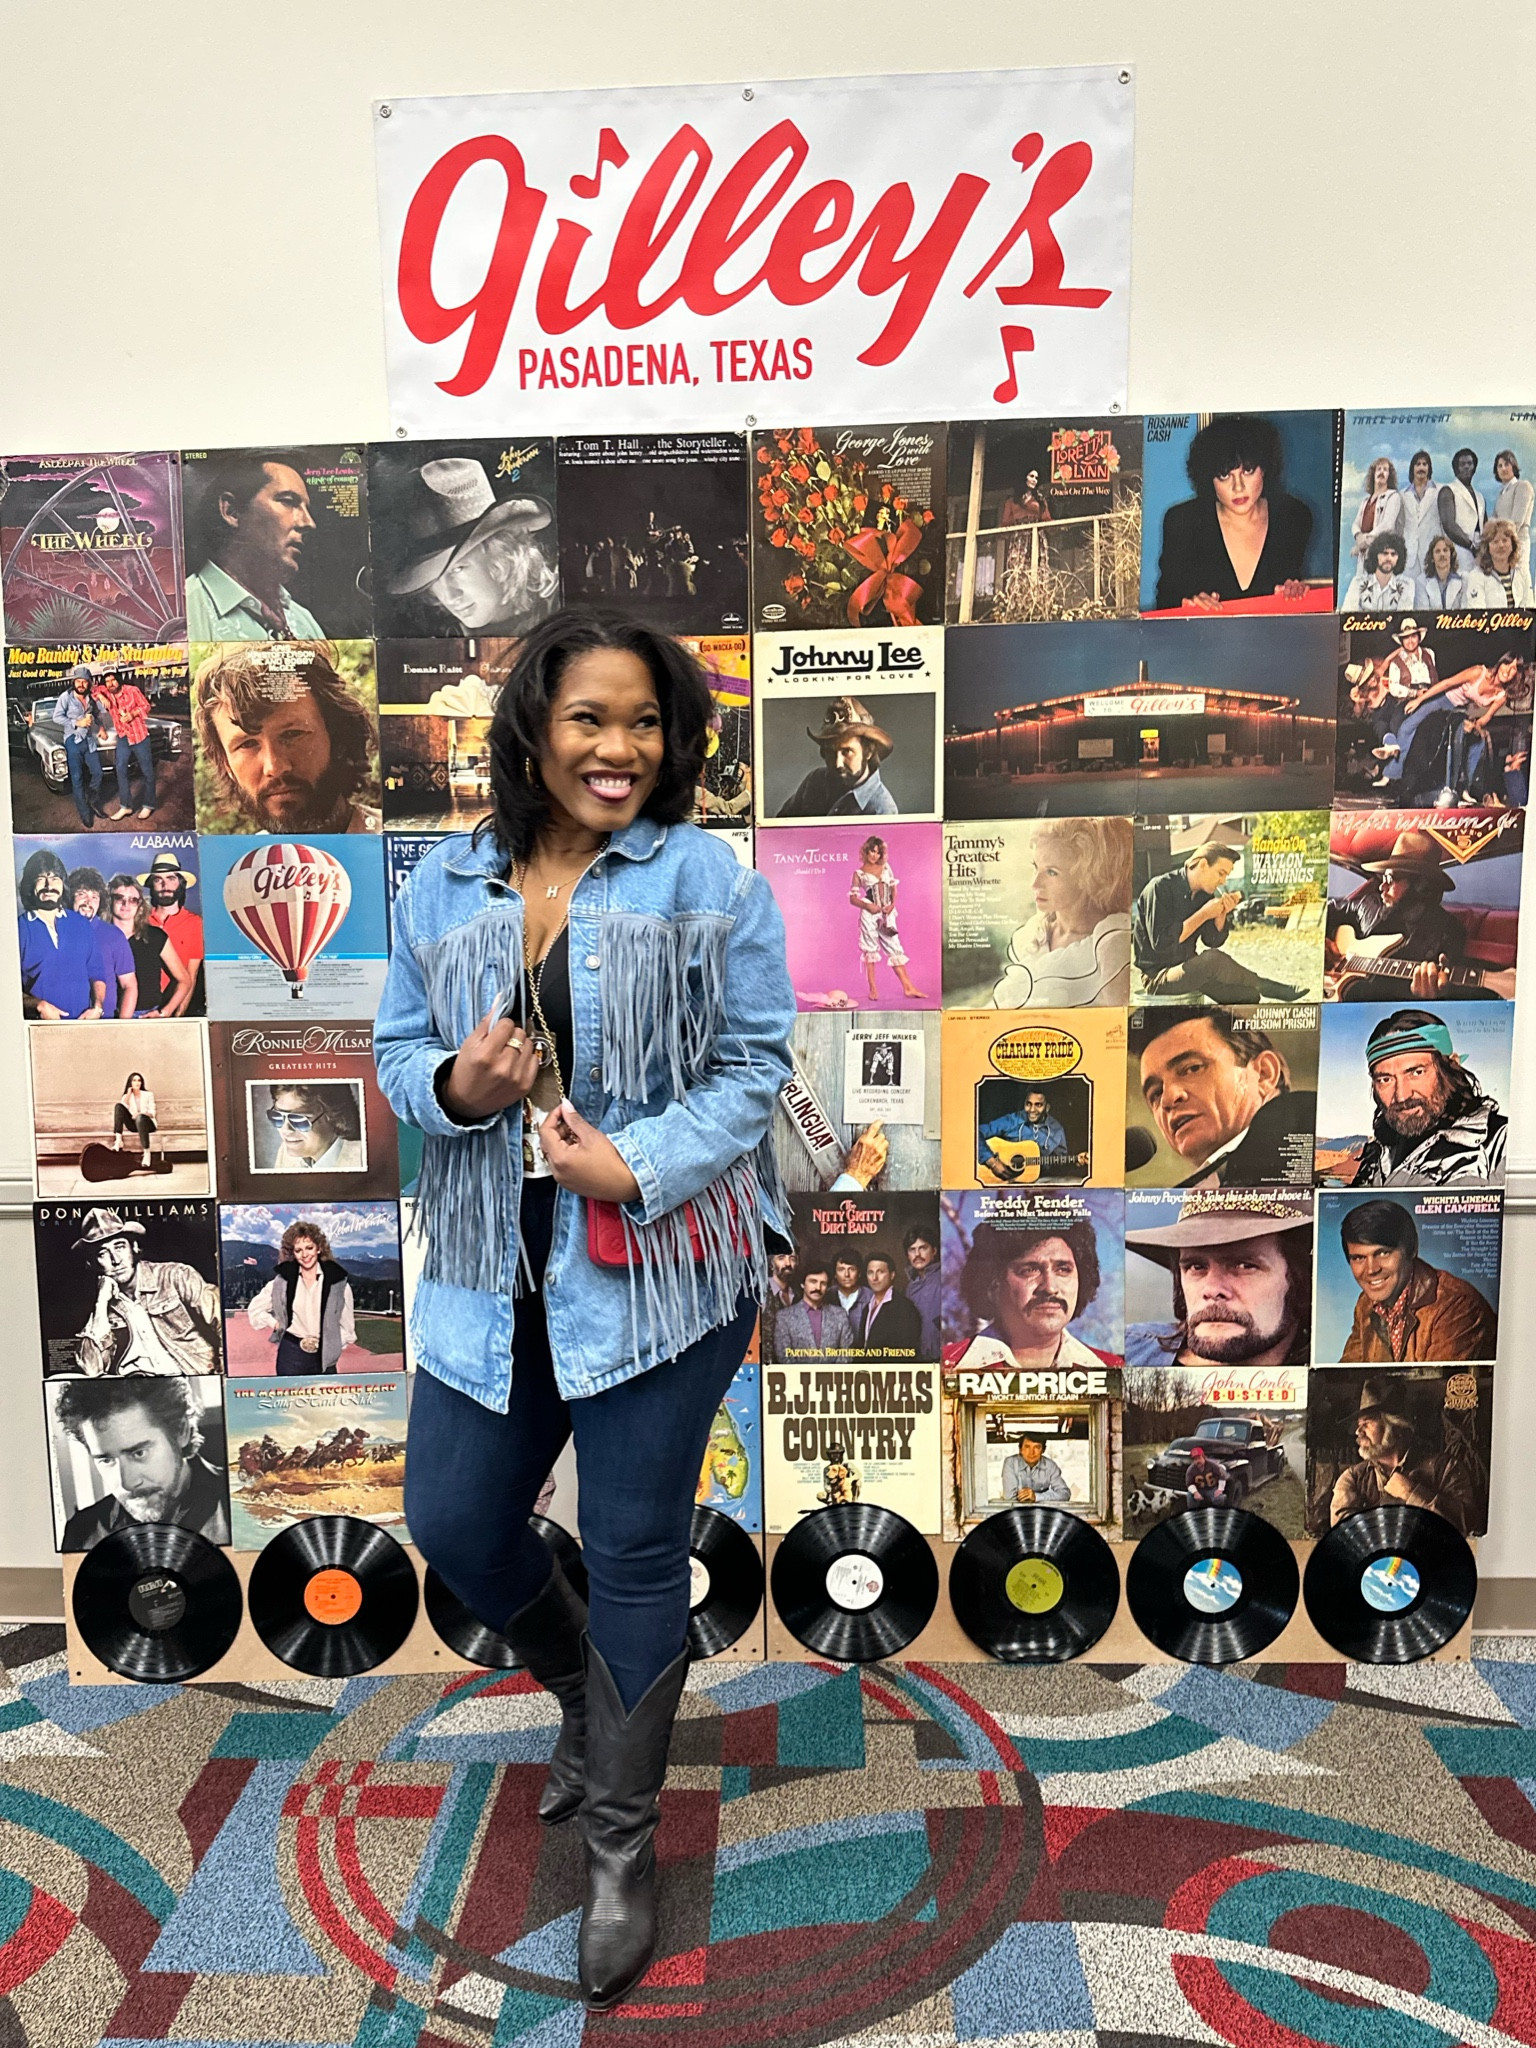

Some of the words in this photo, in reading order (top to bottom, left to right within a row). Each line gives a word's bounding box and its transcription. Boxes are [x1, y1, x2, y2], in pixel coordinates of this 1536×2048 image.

[398, 119, 1112, 397] Gilley's
[519, 342, 700, 391] PASADENA,
[711, 338, 813, 383] TEXAS
[1148, 416, 1189, 431] ROSANNE
[1417, 413, 1452, 424] NIGHT
[831, 430, 886, 456] George
[882, 425, 928, 454] Jones
[1147, 429, 1171, 443] CASH
[877, 446, 921, 468] Love
[512, 468, 520, 483] 2
[1074, 462, 1107, 478] LYNN
[31, 533, 75, 550] THE
[75, 531, 152, 549] WHEEL
[1343, 614, 1388, 632] Encore
[1436, 612, 1488, 632] Mickey
[1489, 612, 1533, 631] Gilley
[8, 648, 34, 664] Moe
[36, 647, 80, 665] Bandy
[82, 646, 93, 663] &
[95, 647, 119, 663] Joe
[771, 645, 875, 676] Johnny
[876, 642, 926, 672] Lee
[1130, 697, 1197, 714] Gilley's
[130, 835, 194, 849] ALABAMA
[944, 835, 1005, 851] Tammy's
[773, 853, 808, 864] TANYA
[805, 848, 849, 864] TUCKER
[945, 849, 1001, 863] Greatest
[1252, 853, 1304, 869] WAYLON
[948, 863, 977, 877] Hits
[1251, 868, 1315, 883] JENNINGS
[254, 864, 342, 898] Gilley's
[546, 886, 558, 899] H
[1253, 1007, 1291, 1018] JOHNNY
[1292, 1007, 1316, 1018] CASH
[1233, 1019, 1244, 1030] AT
[1245, 1019, 1281, 1030] FOLSOM
[1282, 1018, 1316, 1029] PRISON
[232, 1029, 303, 1056] RONNIE
[303, 1026, 372, 1055] MILSAP
[996, 1042, 1042, 1059] CHARLEY
[1045, 1041, 1074, 1058] PRIDE
[782, 1082, 835, 1151] RLINGUA!
[980, 1194, 1031, 1211] Freddy
[1034, 1194, 1085, 1208] Fender
[1129, 1191, 1161, 1204] Johnny
[1204, 1190, 1224, 1201] Take
[1259, 1189, 1277, 1201] and
[1278, 1189, 1302, 1201] shove
[1303, 1189, 1312, 1200] it.
[1423, 1196, 1460, 1204] WICHITA
[1461, 1195, 1501, 1203] LINEMAN
[40, 1208, 82, 1219] DON
[107, 1204, 208, 1217] WILLIAMS
[812, 1209, 845, 1222] NITTY
[846, 1209, 885, 1222] GRITTY
[974, 1209, 999, 1217] Before
[999, 1209, 1014, 1217] The
[1016, 1209, 1035, 1217] Next
[1036, 1209, 1072, 1218] Teardrop
[1072, 1208, 1092, 1217] Falls
[1414, 1204, 1442, 1214] GLEN
[1444, 1204, 1500, 1213] CAMPBELL
[820, 1221, 846, 1234] DIRT
[847, 1221, 878, 1234] BAND
[825, 1347, 865, 1357] BROTHERS
[865, 1348, 881, 1357] AND
[883, 1347, 916, 1357] FRIENDS
[959, 1372, 1016, 1395] RAY
[1018, 1371, 1107, 1395] PRICE
[1201, 1370, 1244, 1400] John
[1249, 1370, 1295, 1390] Conlee
[783, 1418, 916, 1461] COUNTRY
